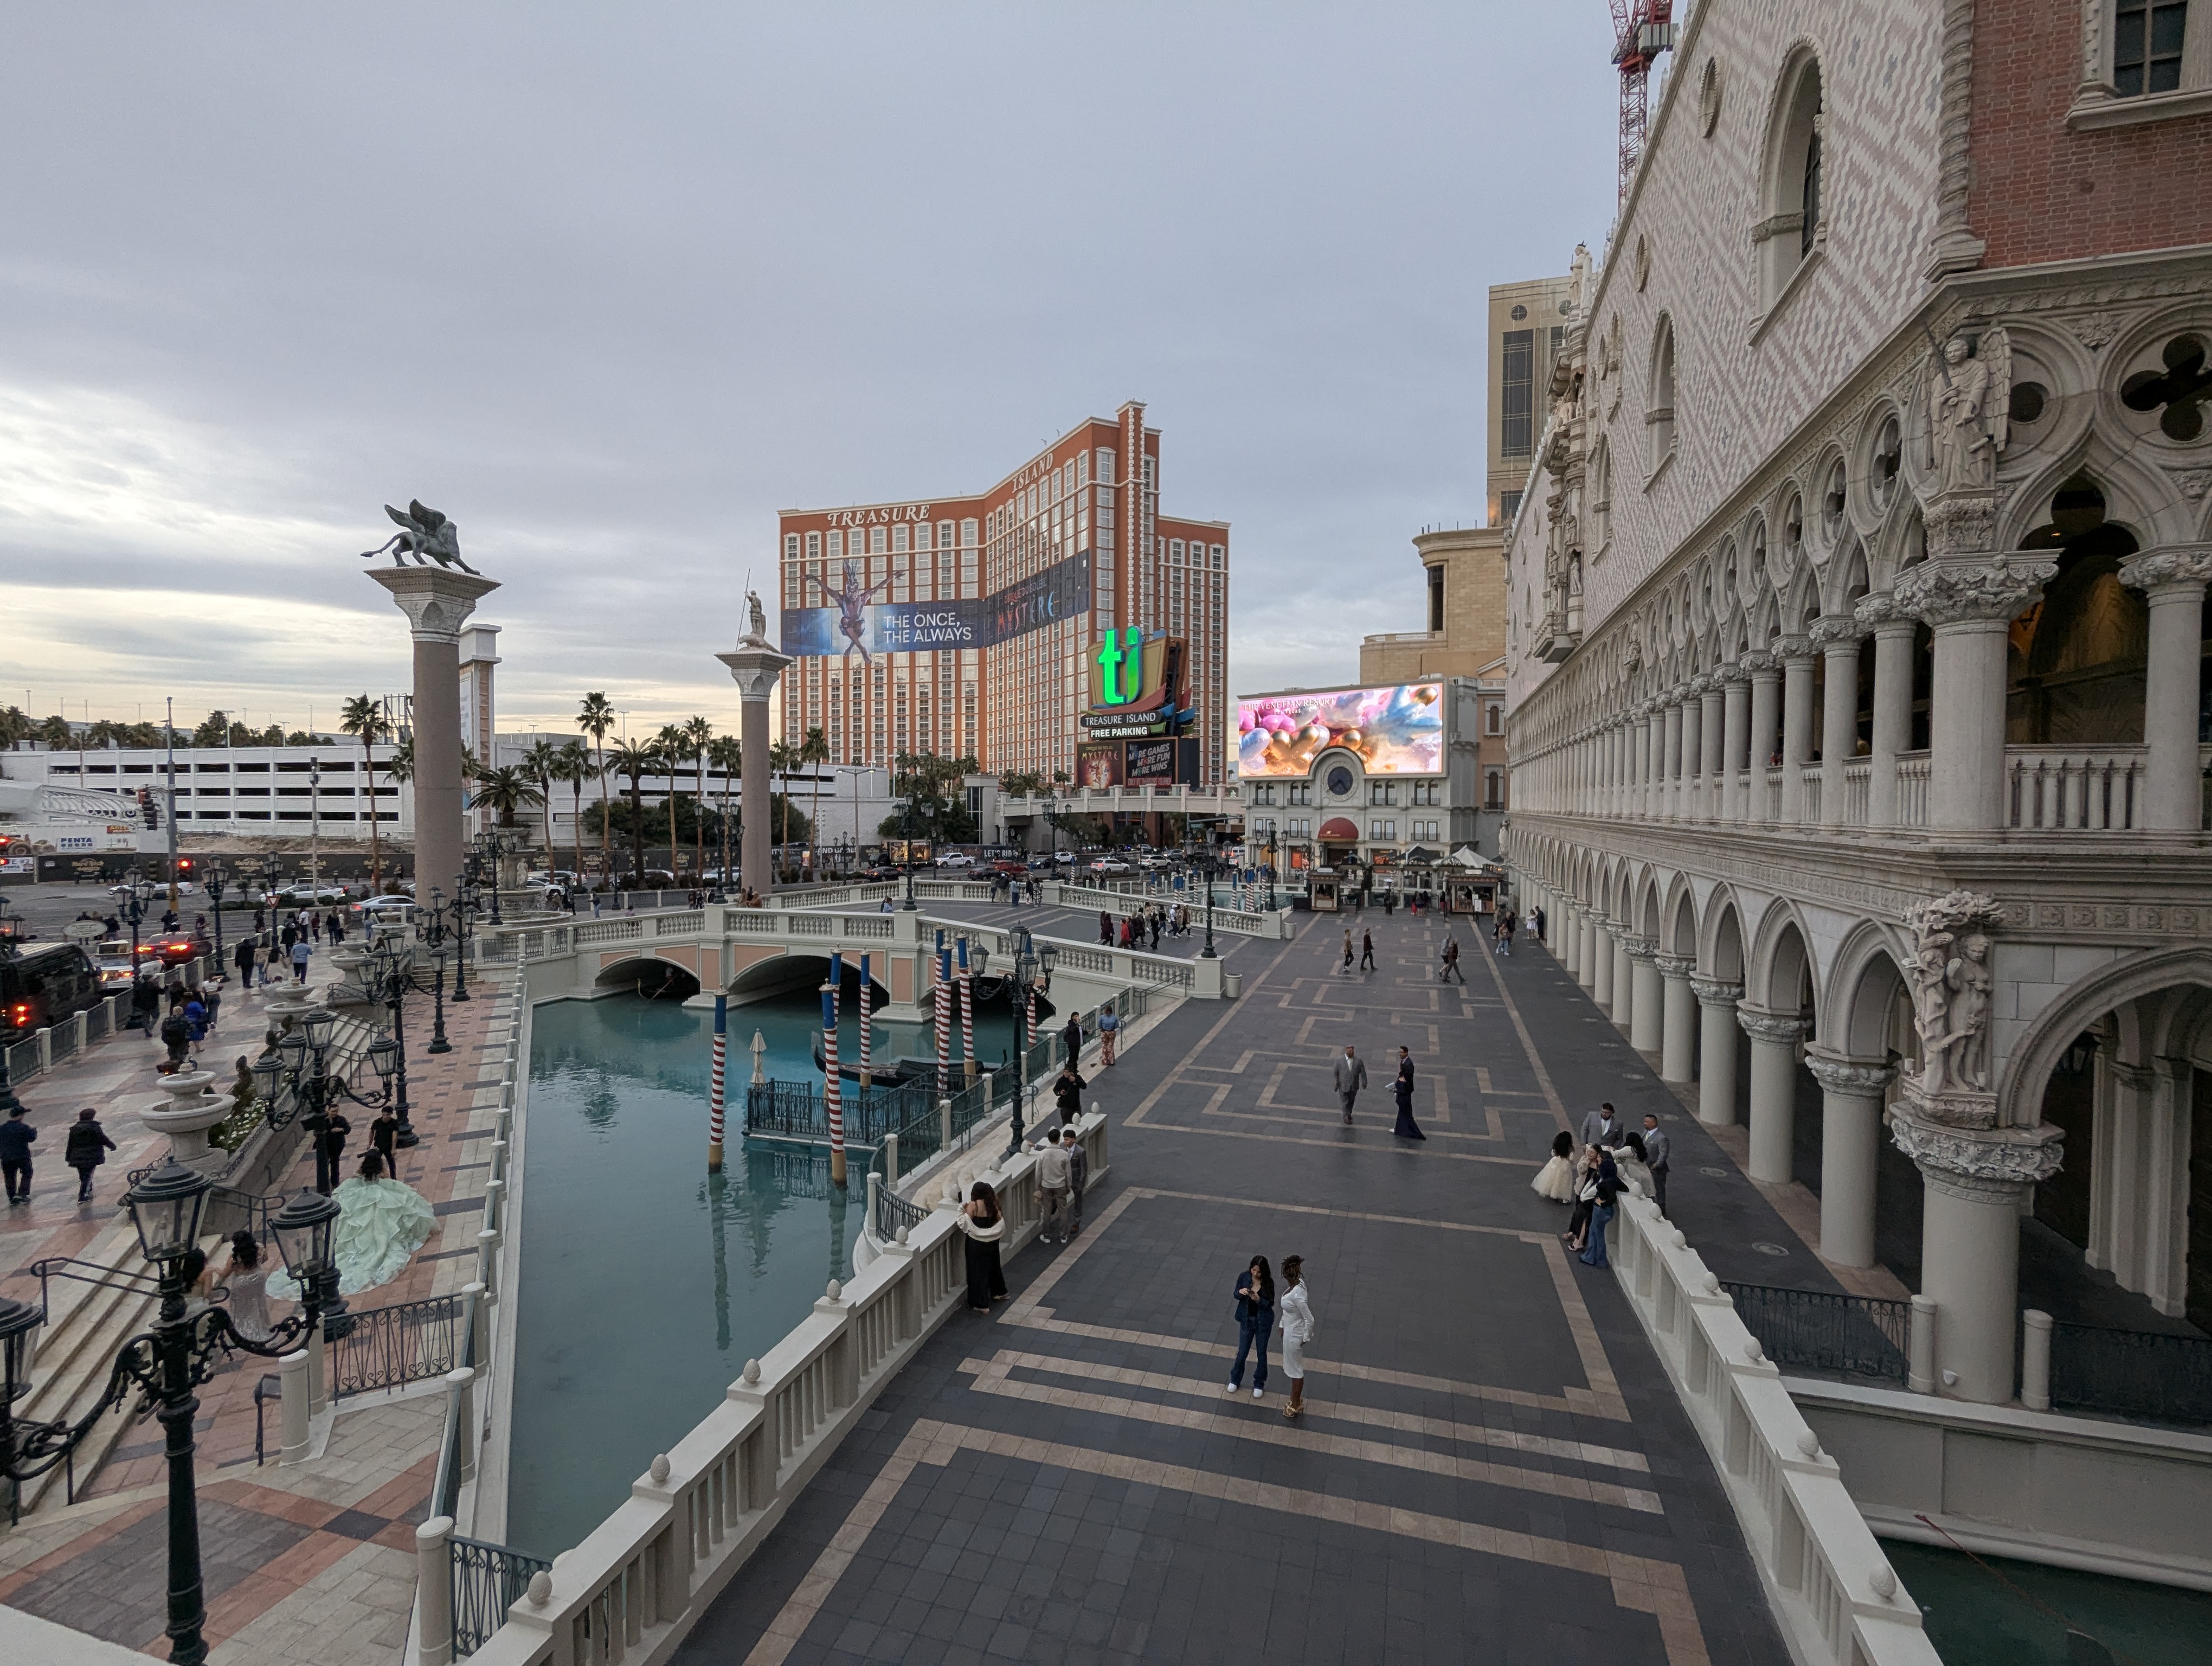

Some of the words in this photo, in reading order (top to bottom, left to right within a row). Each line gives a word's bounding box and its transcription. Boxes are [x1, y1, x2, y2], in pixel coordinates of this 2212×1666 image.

[1012, 452, 1053, 494] ISLAND
[827, 505, 930, 527] TREASURE
[883, 615, 910, 629] THE
[914, 612, 961, 627] ONCE,
[883, 630, 910, 644] THE
[914, 626, 972, 643] ALWAYS
[1258, 700, 1301, 710] VENETIAN
[1302, 697, 1336, 707] RESORT
[1085, 715, 1122, 726] TREASURE
[1126, 712, 1156, 723] ISLAND
[1090, 729, 1110, 738] FREE
[1111, 727, 1148, 736] PARKING
[1147, 743, 1170, 756] GAMES
[1156, 752, 1171, 762] FUN
[1151, 761, 1168, 772] WINS
